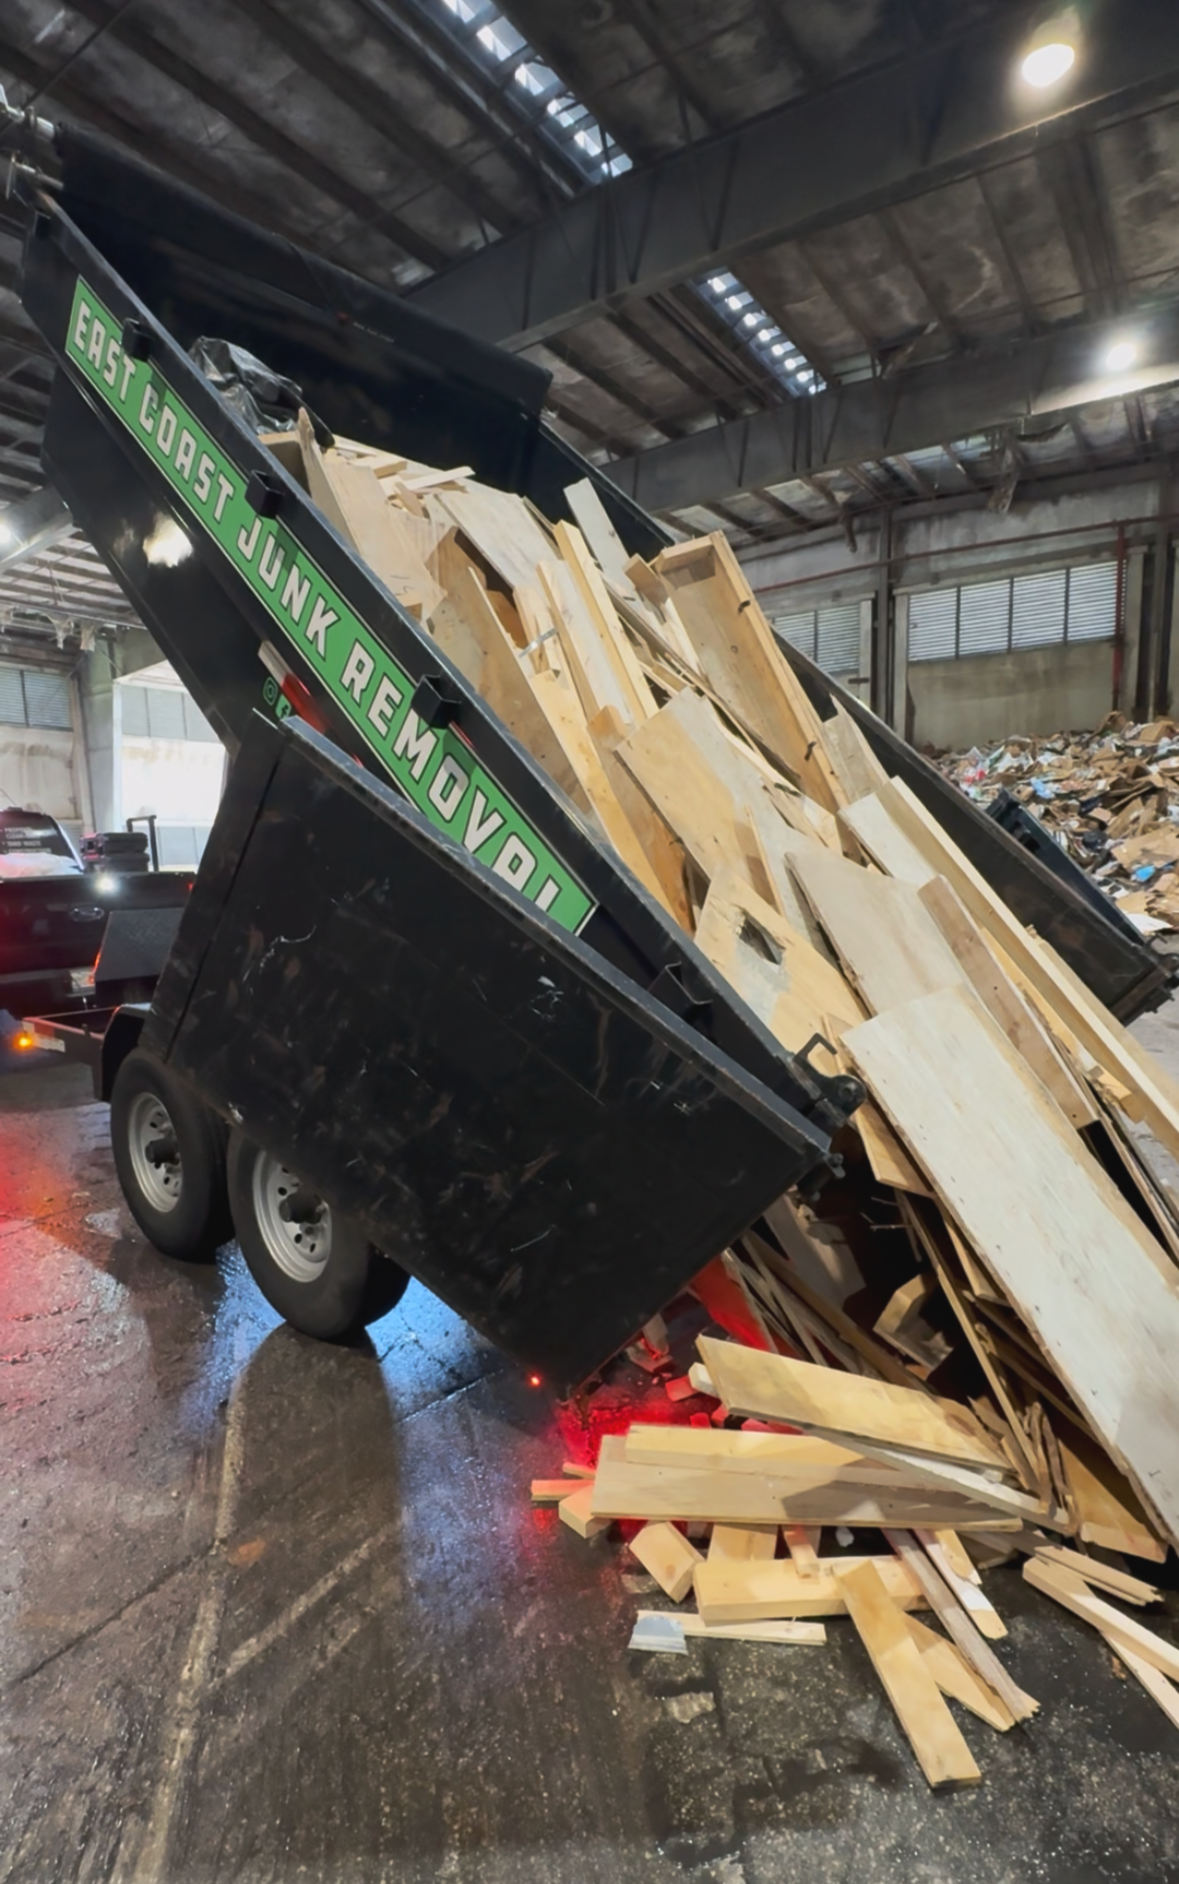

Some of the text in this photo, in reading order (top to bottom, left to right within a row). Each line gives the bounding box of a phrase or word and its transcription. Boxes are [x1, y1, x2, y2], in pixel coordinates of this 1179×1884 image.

[72, 300, 136, 402] EAST
[138, 382, 236, 523] COAST
[236, 516, 341, 661] JUNK
